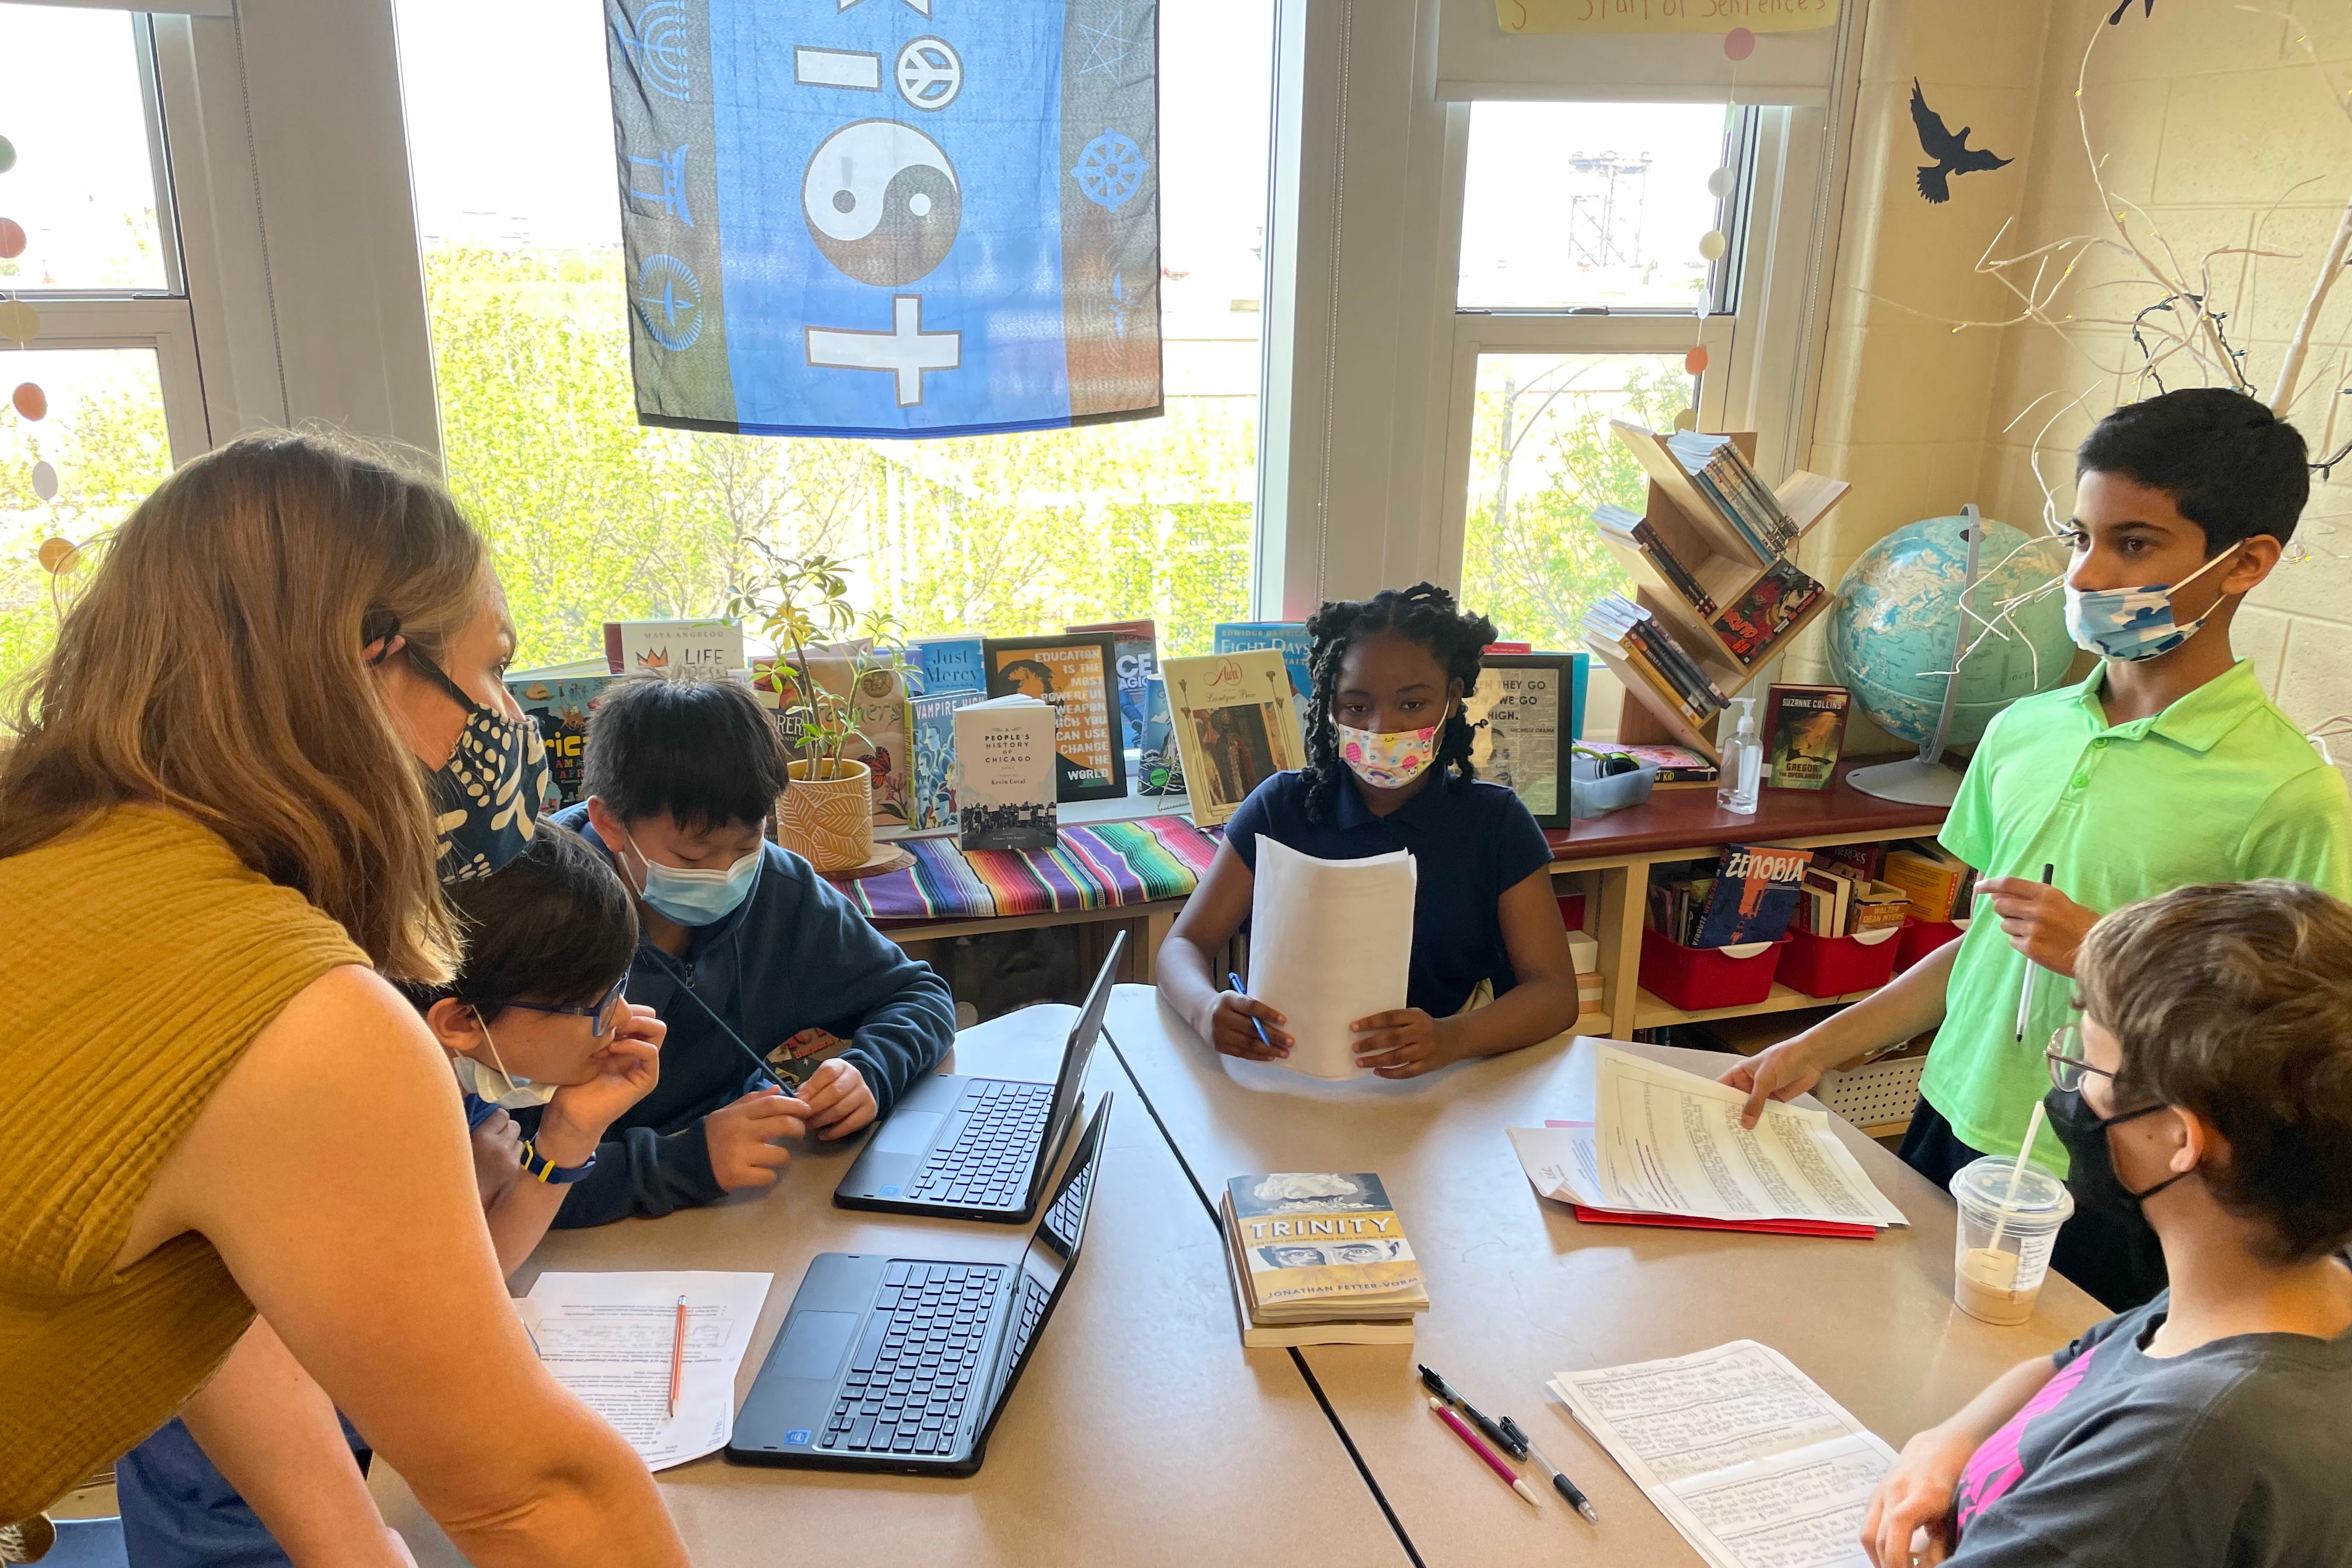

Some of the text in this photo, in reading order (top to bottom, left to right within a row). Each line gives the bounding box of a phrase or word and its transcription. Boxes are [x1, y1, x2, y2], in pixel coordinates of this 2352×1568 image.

[676, 631, 724, 639] ANGELOU
[1221, 638, 1311, 655] EIGHT DAYS
[685, 648, 724, 665] LIFE
[933, 648, 968, 666] Just
[1035, 649, 1101, 663] EDUCATION
[1063, 662, 1101, 674] IS THE
[925, 667, 978, 684] Mercy
[1071, 676, 1102, 687] MOST
[1497, 681, 1522, 689] THEY
[1528, 681, 1546, 690] GO
[1040, 690, 1104, 702] POWERFUL
[1499, 696, 1514, 705] WE
[1519, 696, 1537, 705] GO
[915, 700, 957, 720] VAMPIRE
[1055, 702, 1106, 716] WEAPON
[1782, 698, 1842, 709] SUZANNE COLLINS
[1084, 715, 1107, 726] YOU
[1488, 711, 1518, 720] HIGH.
[1056, 728, 1108, 741] CAN USE
[1060, 741, 1110, 755] CHANGE
[1087, 754, 1111, 765] THE
[1786, 762, 1818, 772] GREGOR
[1067, 768, 1108, 781] WORLD
[1834, 846, 1867, 865] HEROES
[1725, 852, 1805, 883] ZENOBIA
[1874, 905, 1900, 914] WALTER
[1863, 912, 1905, 924] DEAN MYERS
[1249, 1217, 1391, 1239] TRINITY
[1268, 1276, 1418, 1299] JONATHAN FETTER-VORM
